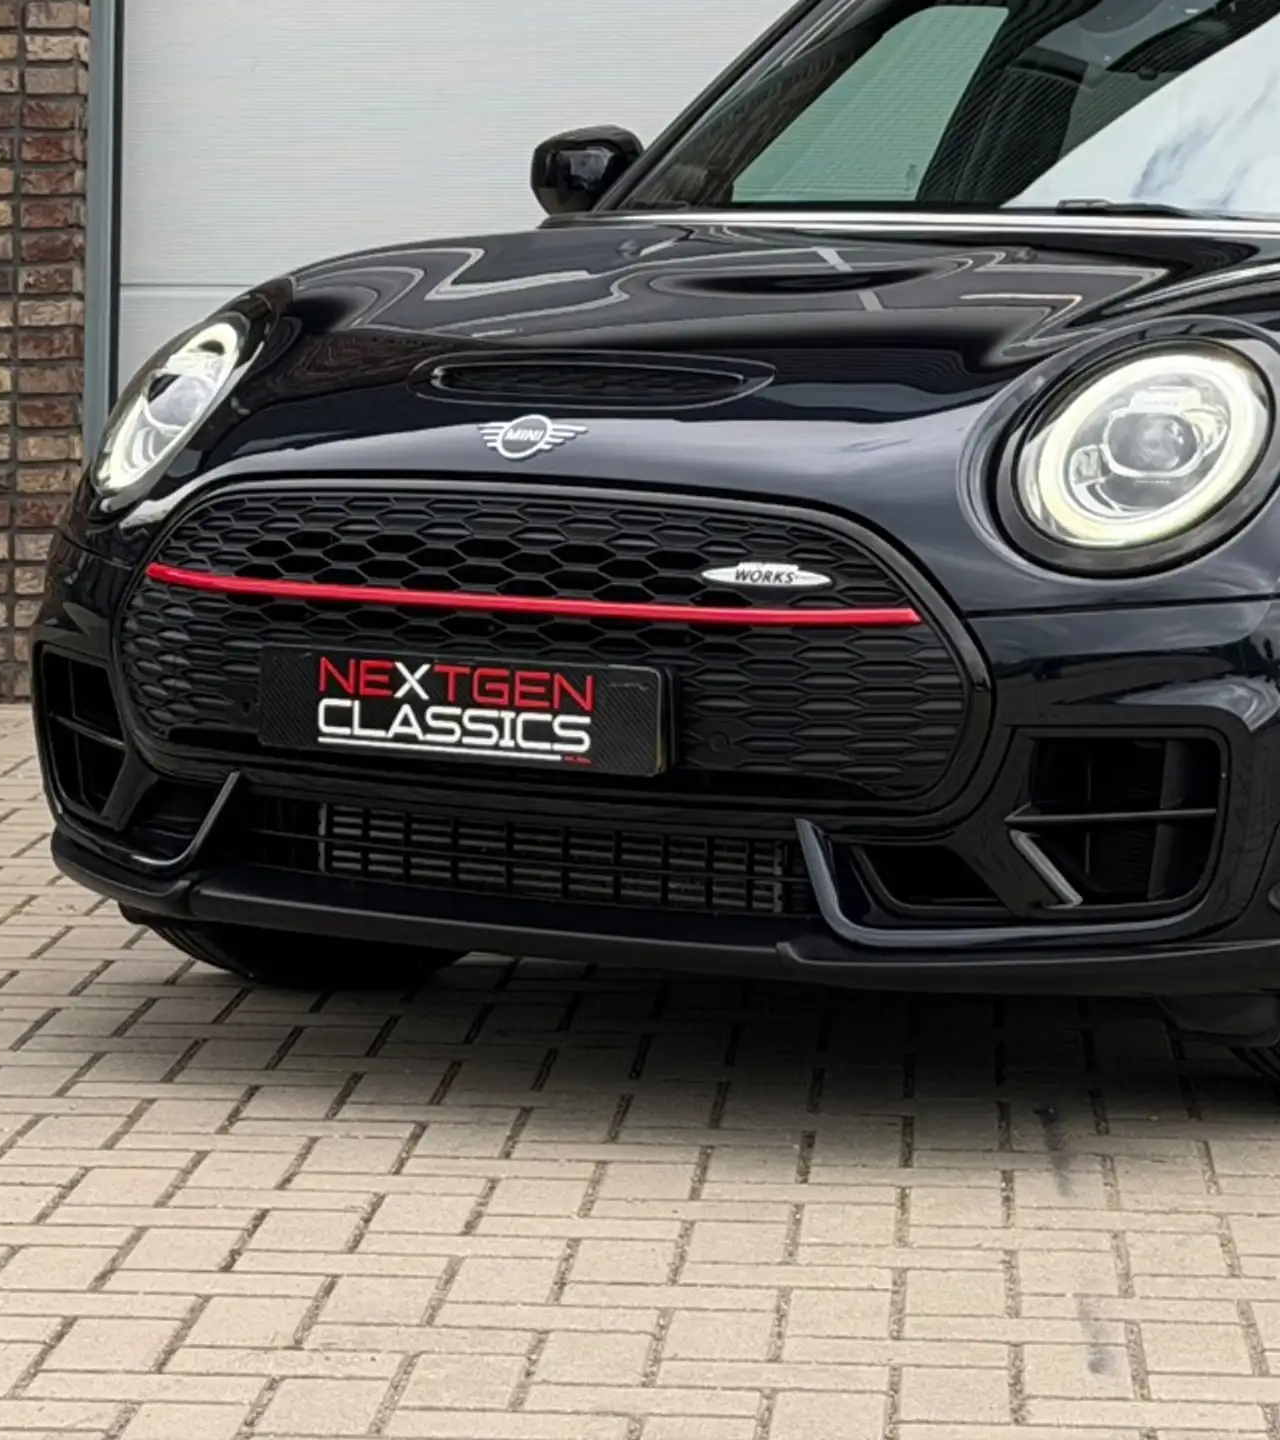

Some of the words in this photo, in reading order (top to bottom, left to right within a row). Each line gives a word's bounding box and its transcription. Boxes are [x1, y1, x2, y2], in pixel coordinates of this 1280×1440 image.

[503, 426, 546, 441] MINI
[735, 569, 795, 584] WORKS
[319, 656, 595, 712] NEXTGEN
[317, 698, 592, 753] CLASSICS
